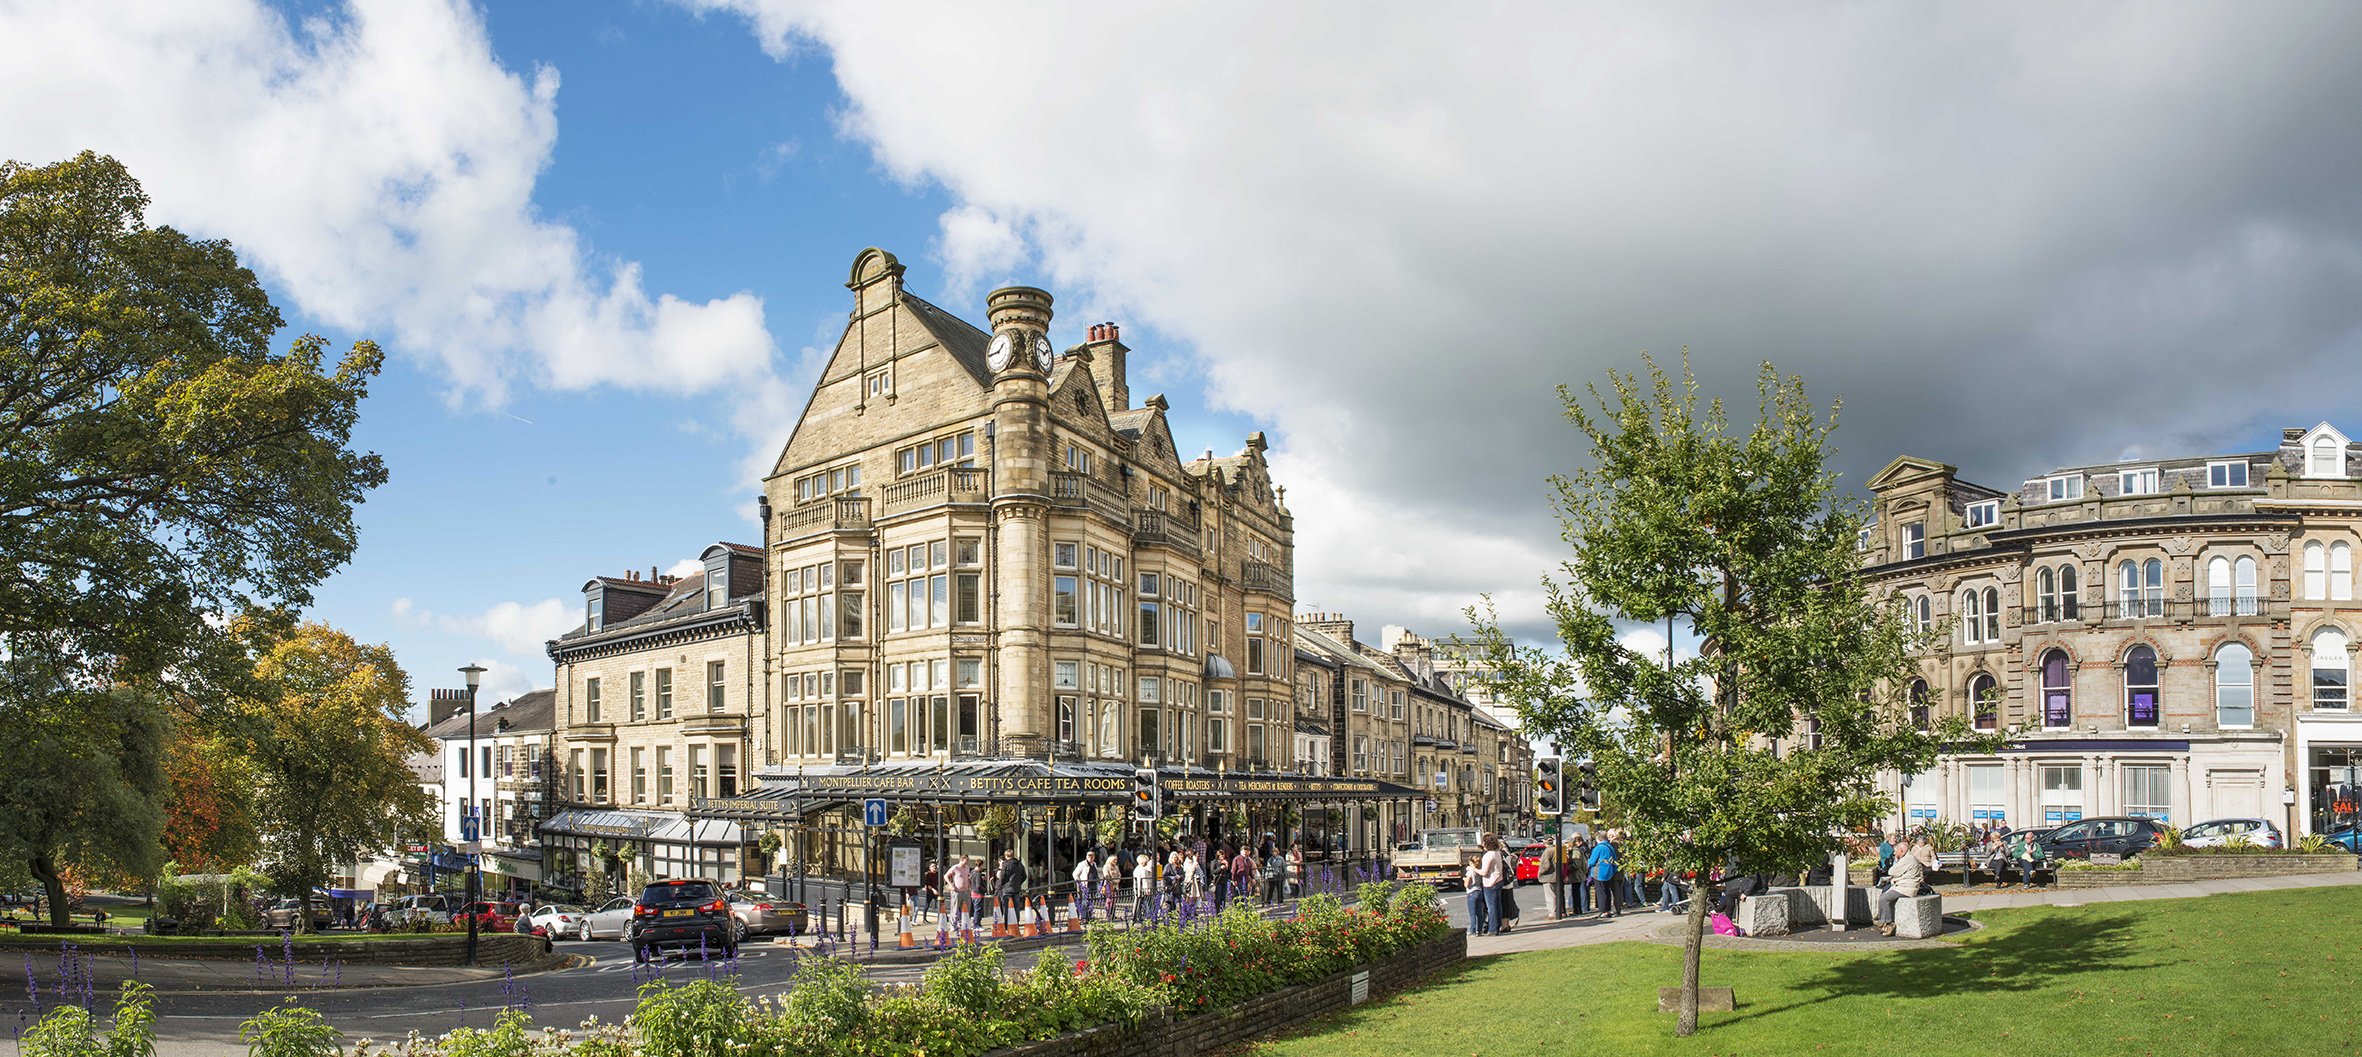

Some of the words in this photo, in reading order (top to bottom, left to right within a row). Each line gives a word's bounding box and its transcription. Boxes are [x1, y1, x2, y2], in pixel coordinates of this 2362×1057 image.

[819, 777, 872, 788] MONTPELLIER
[873, 777, 895, 788] CAFE
[897, 777, 914, 788] BAR
[970, 778, 1014, 790] BETTYS
[1018, 778, 1051, 790] CAFE
[1055, 778, 1080, 790] TEA
[1084, 778, 1126, 790] ROOMS
[1164, 780, 1184, 790] COFFEE
[1185, 780, 1210, 790] ROASTERS
[1238, 781, 1247, 791] TEA
[707, 800, 728, 809] BETTYS
[729, 800, 758, 810] IMPERIAL
[760, 800, 778, 810] SUITE
